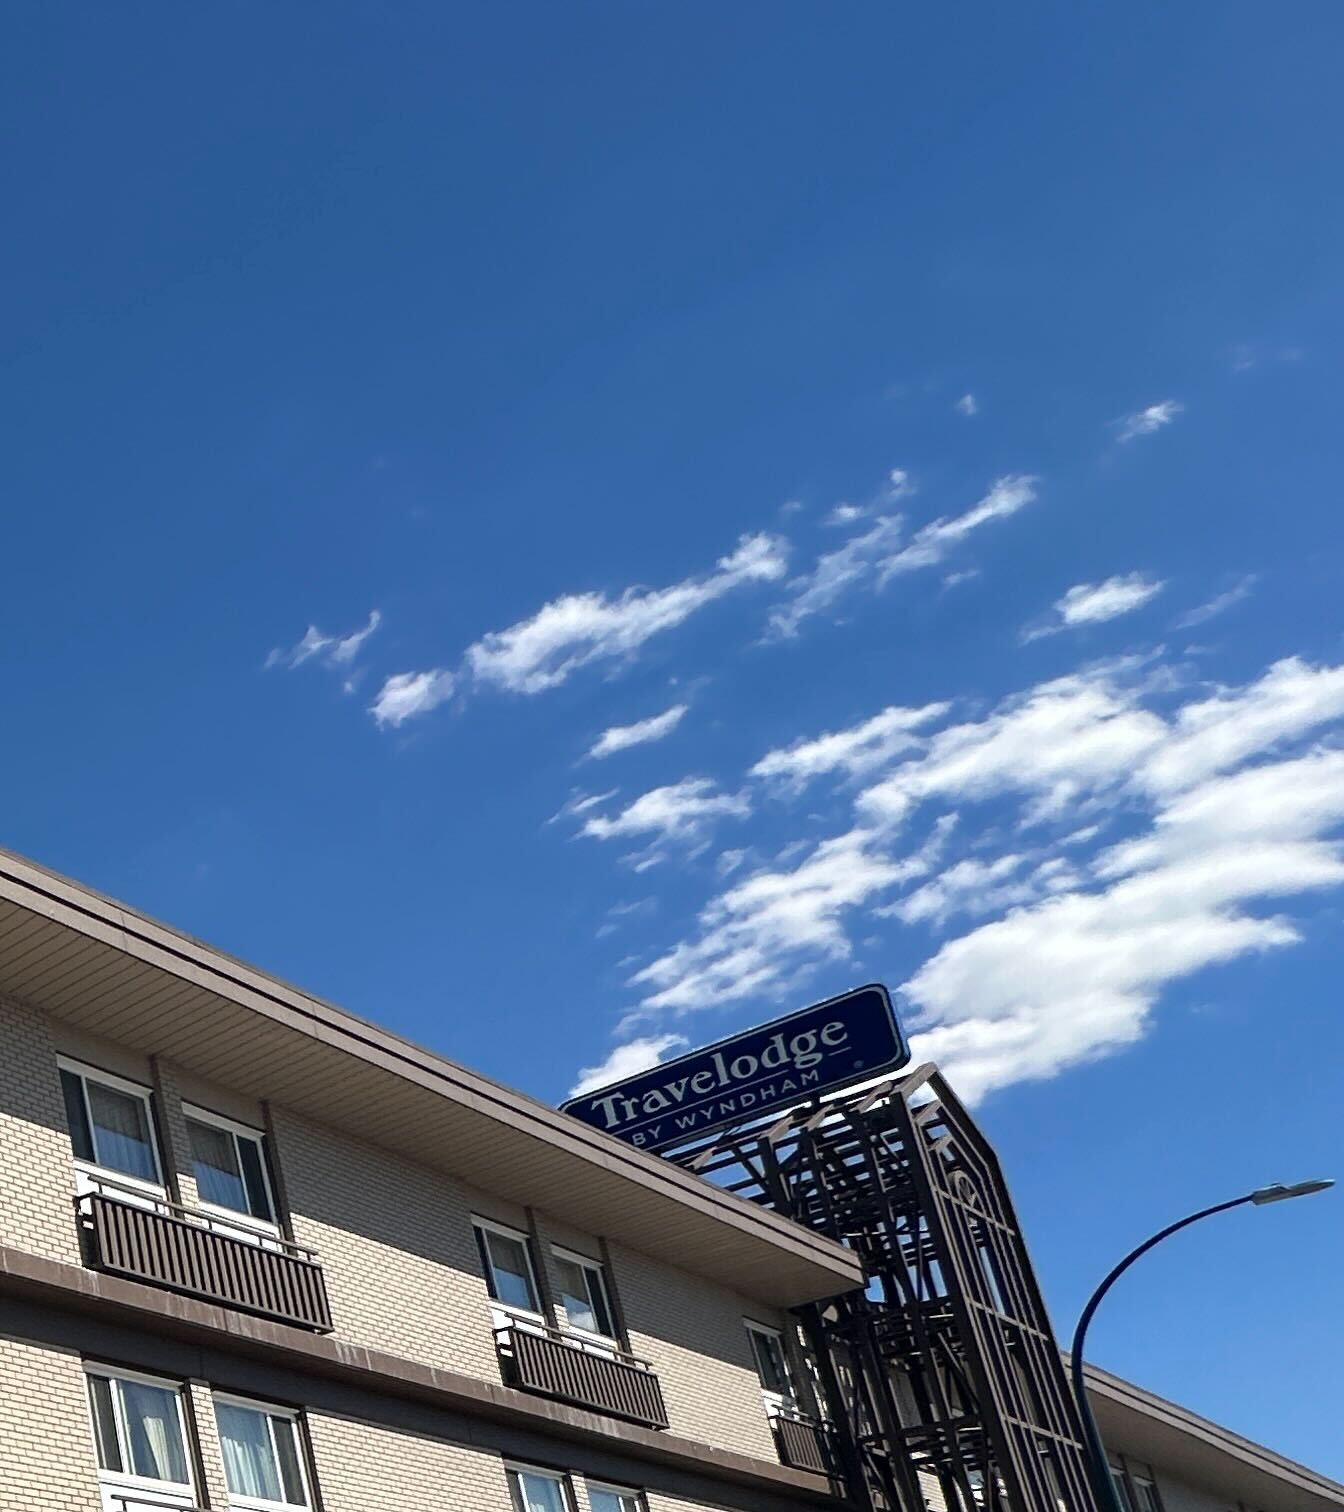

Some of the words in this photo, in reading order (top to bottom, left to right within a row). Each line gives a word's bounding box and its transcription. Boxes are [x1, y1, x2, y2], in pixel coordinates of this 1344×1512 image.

[592, 1021, 849, 1129] Travelodge
[632, 1126, 662, 1146] BY
[675, 1069, 820, 1129] WYNDHAM
